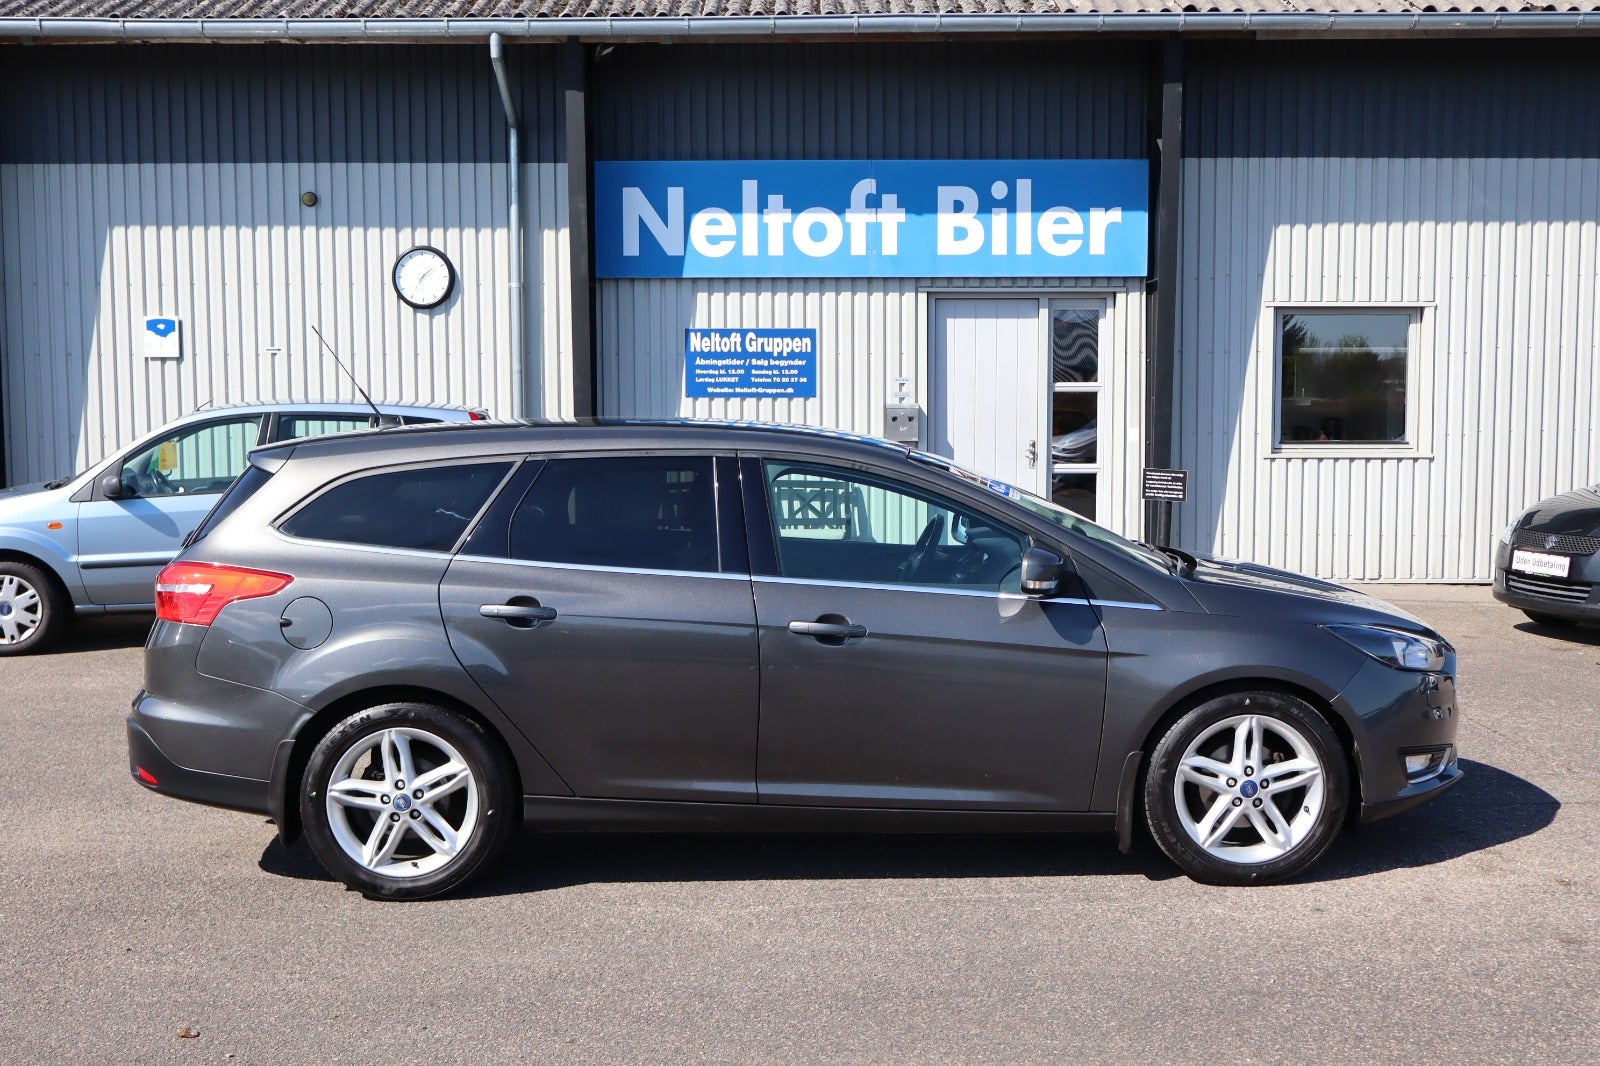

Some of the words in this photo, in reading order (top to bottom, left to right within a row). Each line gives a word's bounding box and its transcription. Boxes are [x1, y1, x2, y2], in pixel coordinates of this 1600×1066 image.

[622, 178, 906, 259] Neltoft
[937, 178, 1123, 258] Biler
[690, 331, 742, 352] Neltoft
[745, 331, 812, 357] Gruppen
[695, 356, 745, 367] Åbningstider
[751, 358, 768, 367] Salg
[770, 358, 807, 367] begynder
[1516, 555, 1531, 565] Uden
[1532, 557, 1566, 572] Udbetaling
